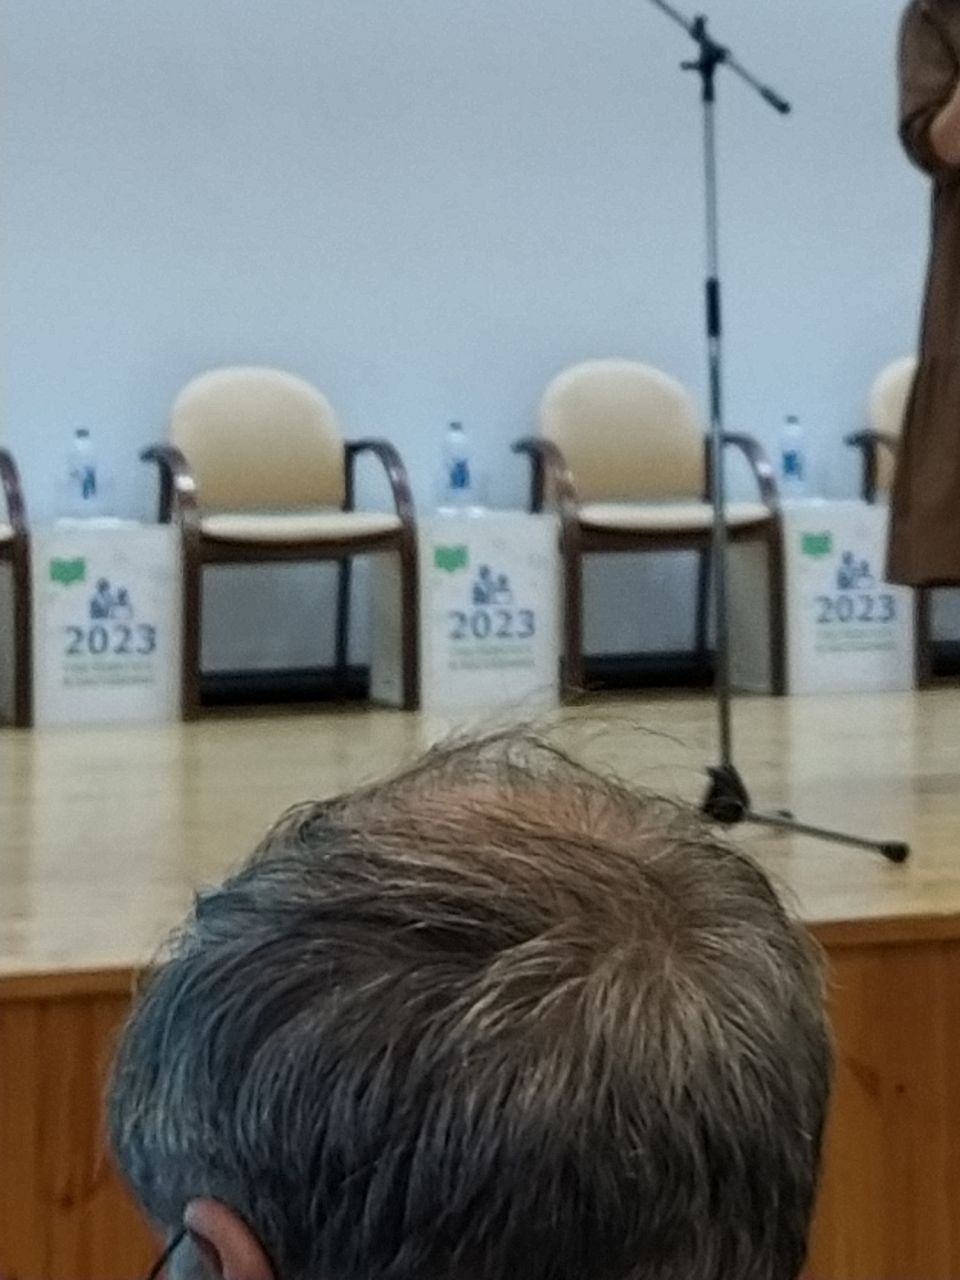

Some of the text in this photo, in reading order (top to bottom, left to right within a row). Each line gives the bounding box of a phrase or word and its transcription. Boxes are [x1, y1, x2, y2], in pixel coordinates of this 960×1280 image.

[815, 594, 896, 623] 2023
[448, 609, 535, 639] 2023
[65, 624, 156, 655] 2023
